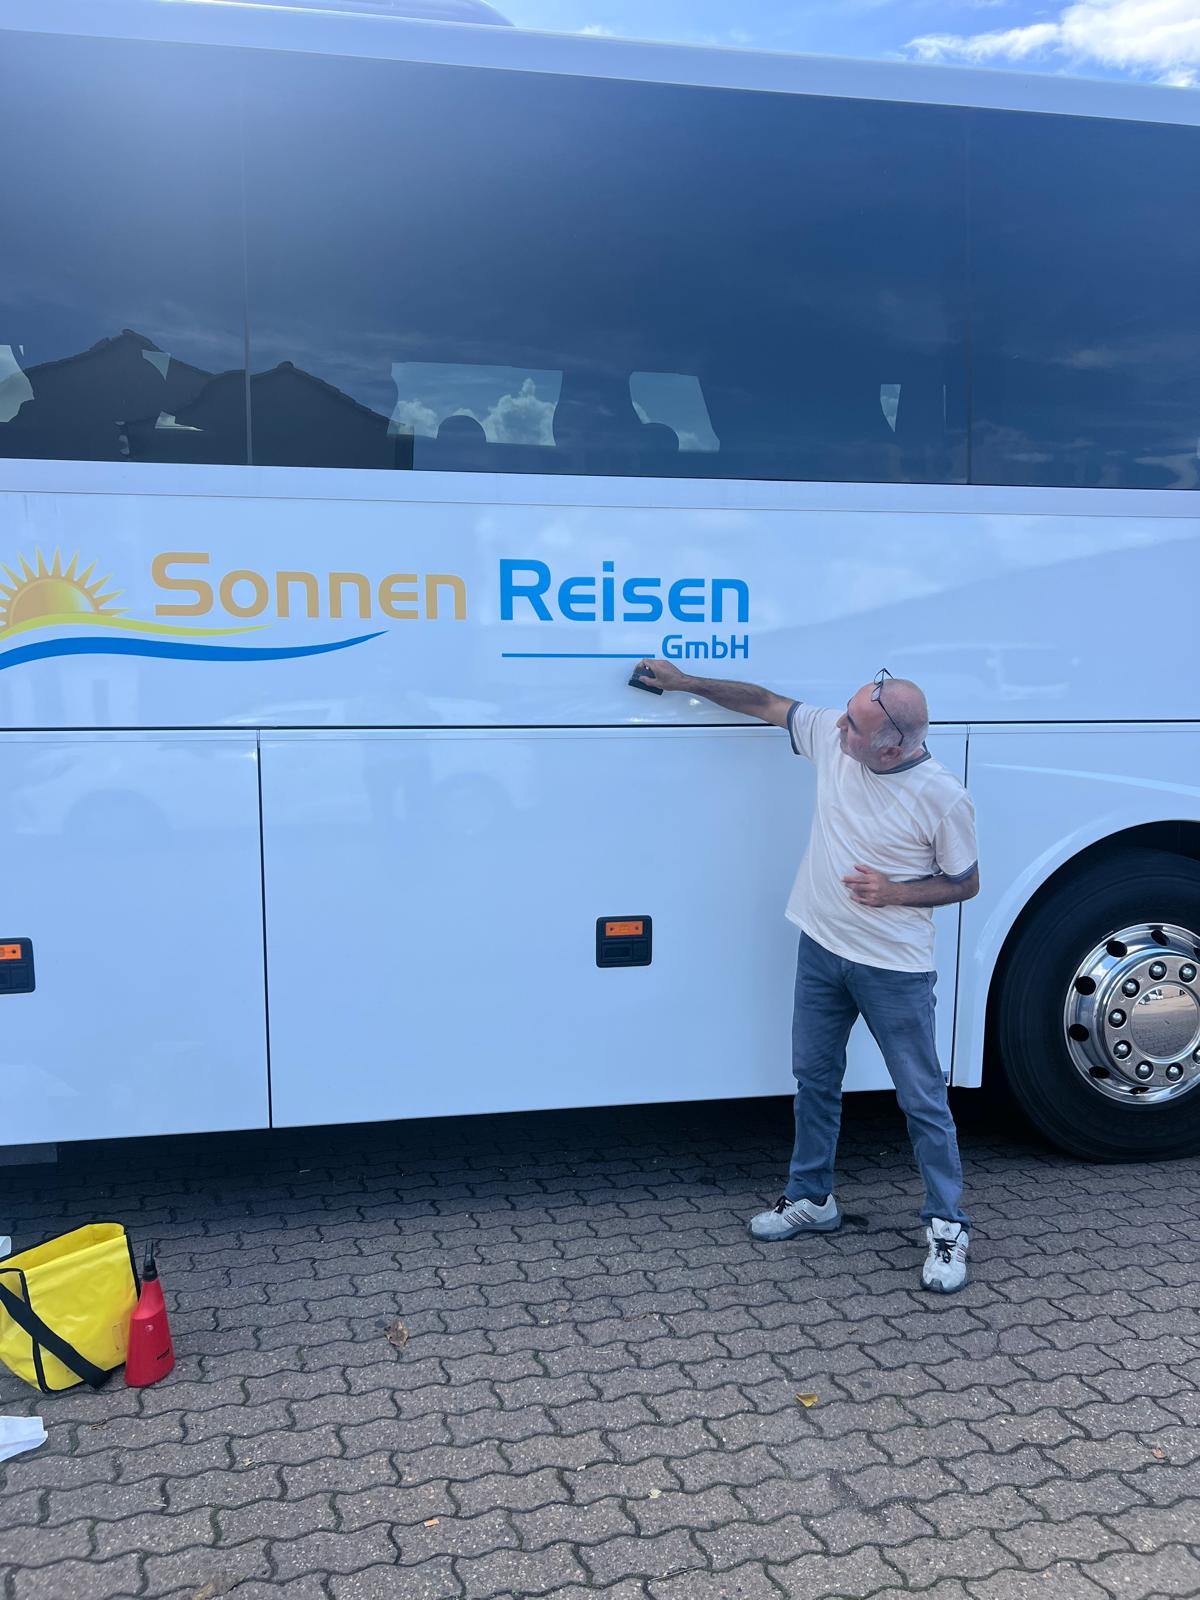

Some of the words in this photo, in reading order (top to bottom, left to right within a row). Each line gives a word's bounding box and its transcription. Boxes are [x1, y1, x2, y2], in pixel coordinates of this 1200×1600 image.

[153, 552, 466, 619] Sonnen
[500, 559, 749, 622] Reisen
[662, 634, 749, 660] GmbH
